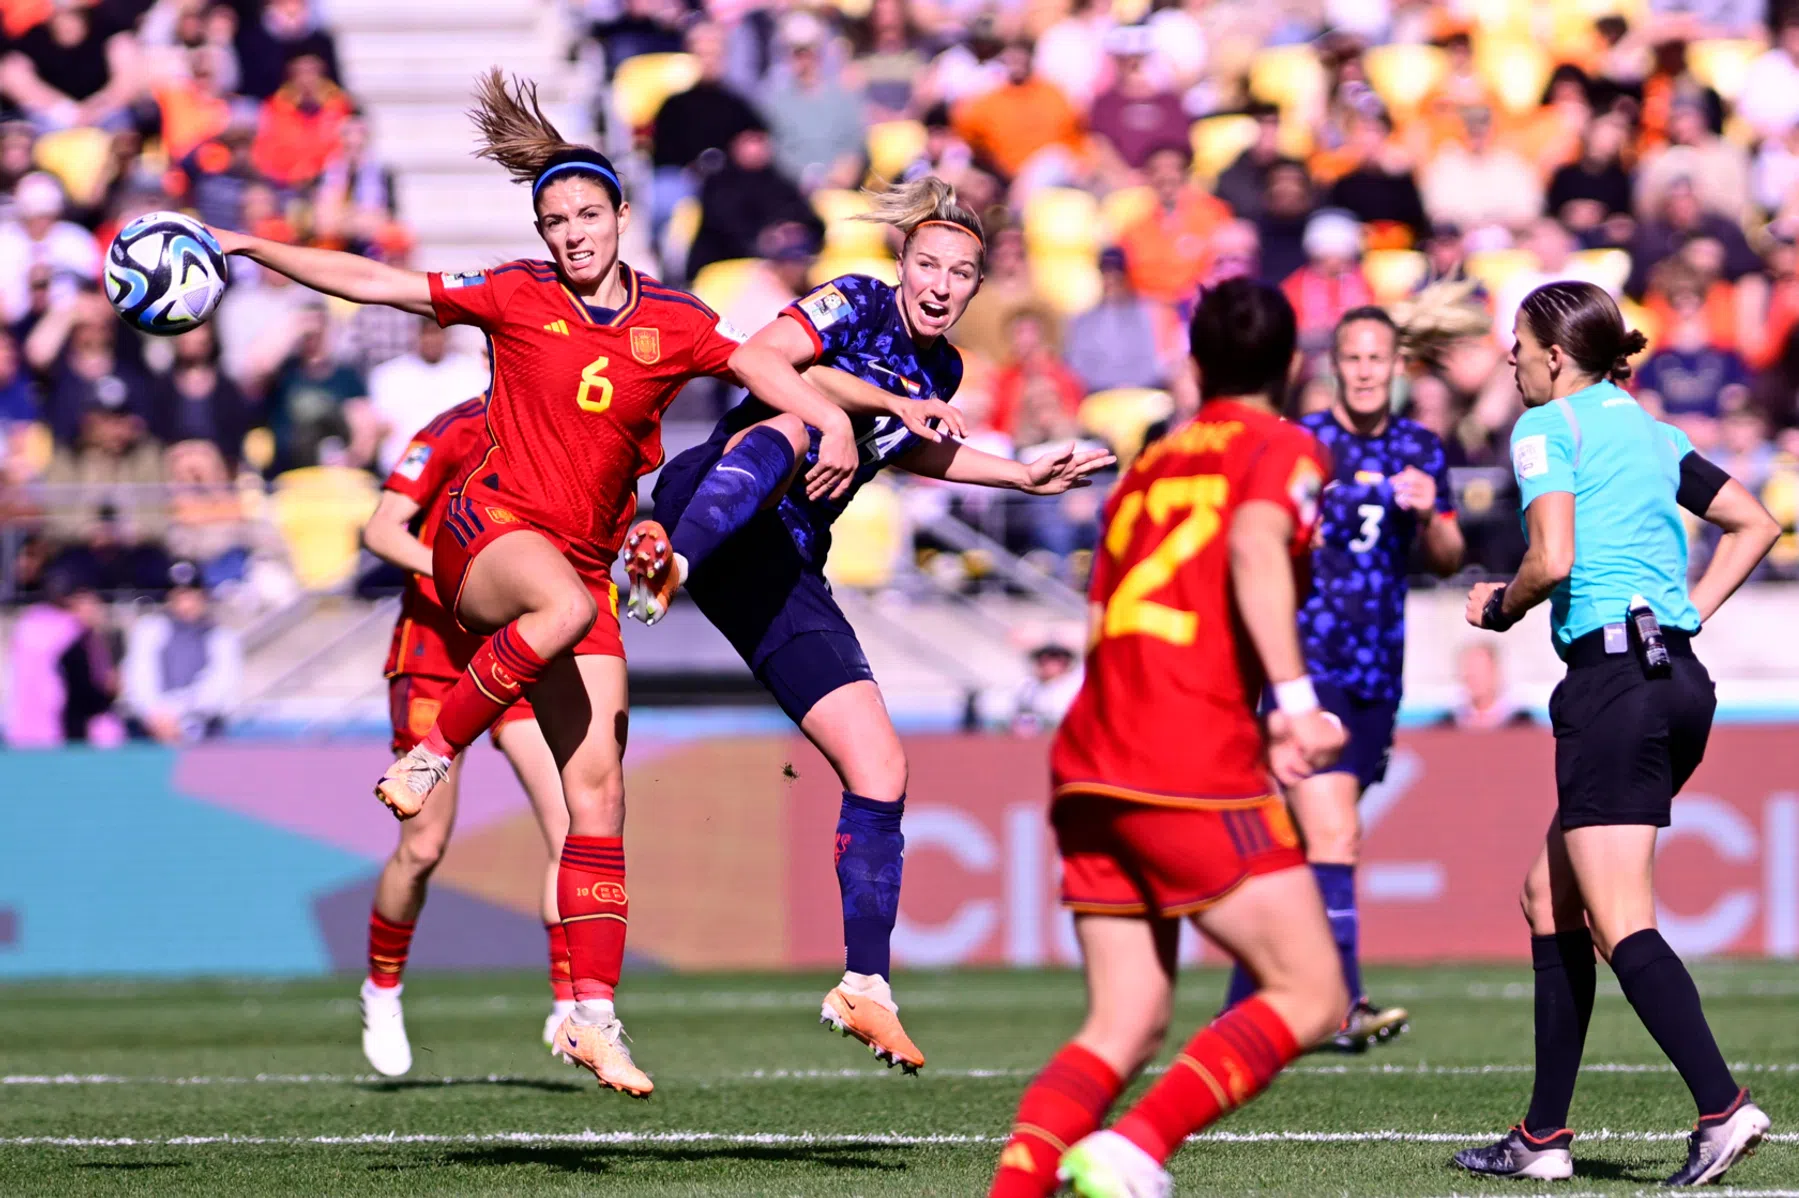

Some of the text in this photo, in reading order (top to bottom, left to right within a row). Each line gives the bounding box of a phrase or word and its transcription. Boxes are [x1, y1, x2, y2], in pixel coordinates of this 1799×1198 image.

[576, 355, 614, 413] 6
[855, 415, 909, 466] 14
[1348, 503, 1385, 553] 3
